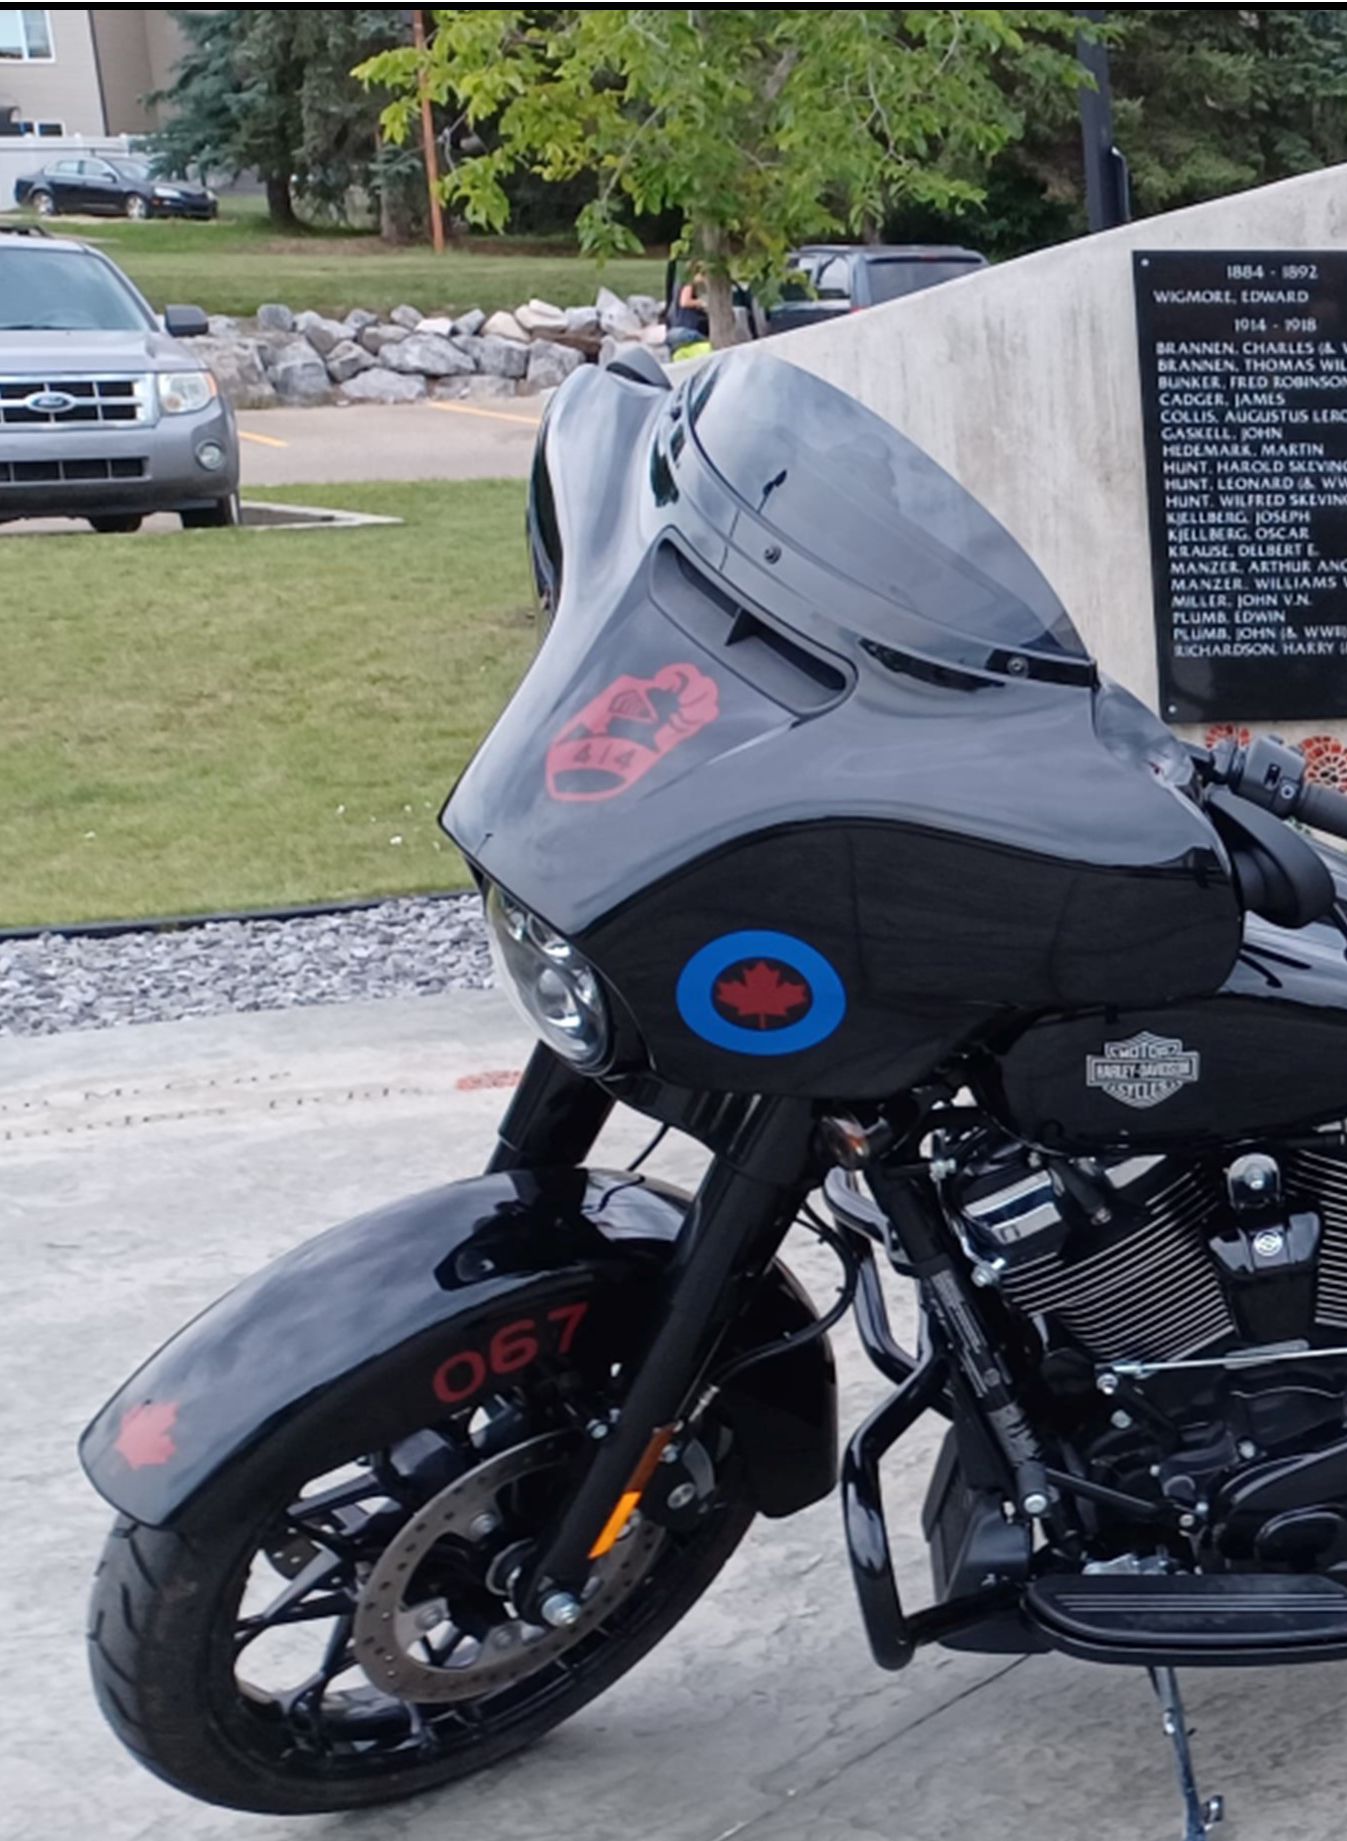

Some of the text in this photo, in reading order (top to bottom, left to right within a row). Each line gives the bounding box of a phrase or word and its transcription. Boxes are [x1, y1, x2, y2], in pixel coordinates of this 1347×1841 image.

[1228, 265, 1264, 279] 1884
[1283, 265, 1317, 279] 1892
[1242, 291, 1309, 303] EDWARD
[1235, 319, 1266, 331] 1914
[1286, 318, 1316, 331] 1918
[1243, 342, 1314, 354] CHARLES
[1245, 358, 1315, 372] THOMAS
[1230, 376, 1268, 389] FRED
[1235, 393, 1285, 408] JAMES
[1225, 410, 1309, 423] AUGUSTUS
[1242, 427, 1282, 441] JOHN
[1261, 443, 1323, 456] MARTIN
[1217, 461, 1284, 473] HAROLD
[1220, 494, 1285, 507] WILFRED
[1255, 527, 1309, 540] OSCAR
[1238, 543, 1301, 557] DELBERT
[1249, 560, 1311, 572] ARTHUR
[1255, 577, 1336, 590] WILLIAMS
[1238, 594, 1277, 608] JOHN
[1235, 611, 1285, 623] EDWIN
[432, 1302, 590, 1406] 067
